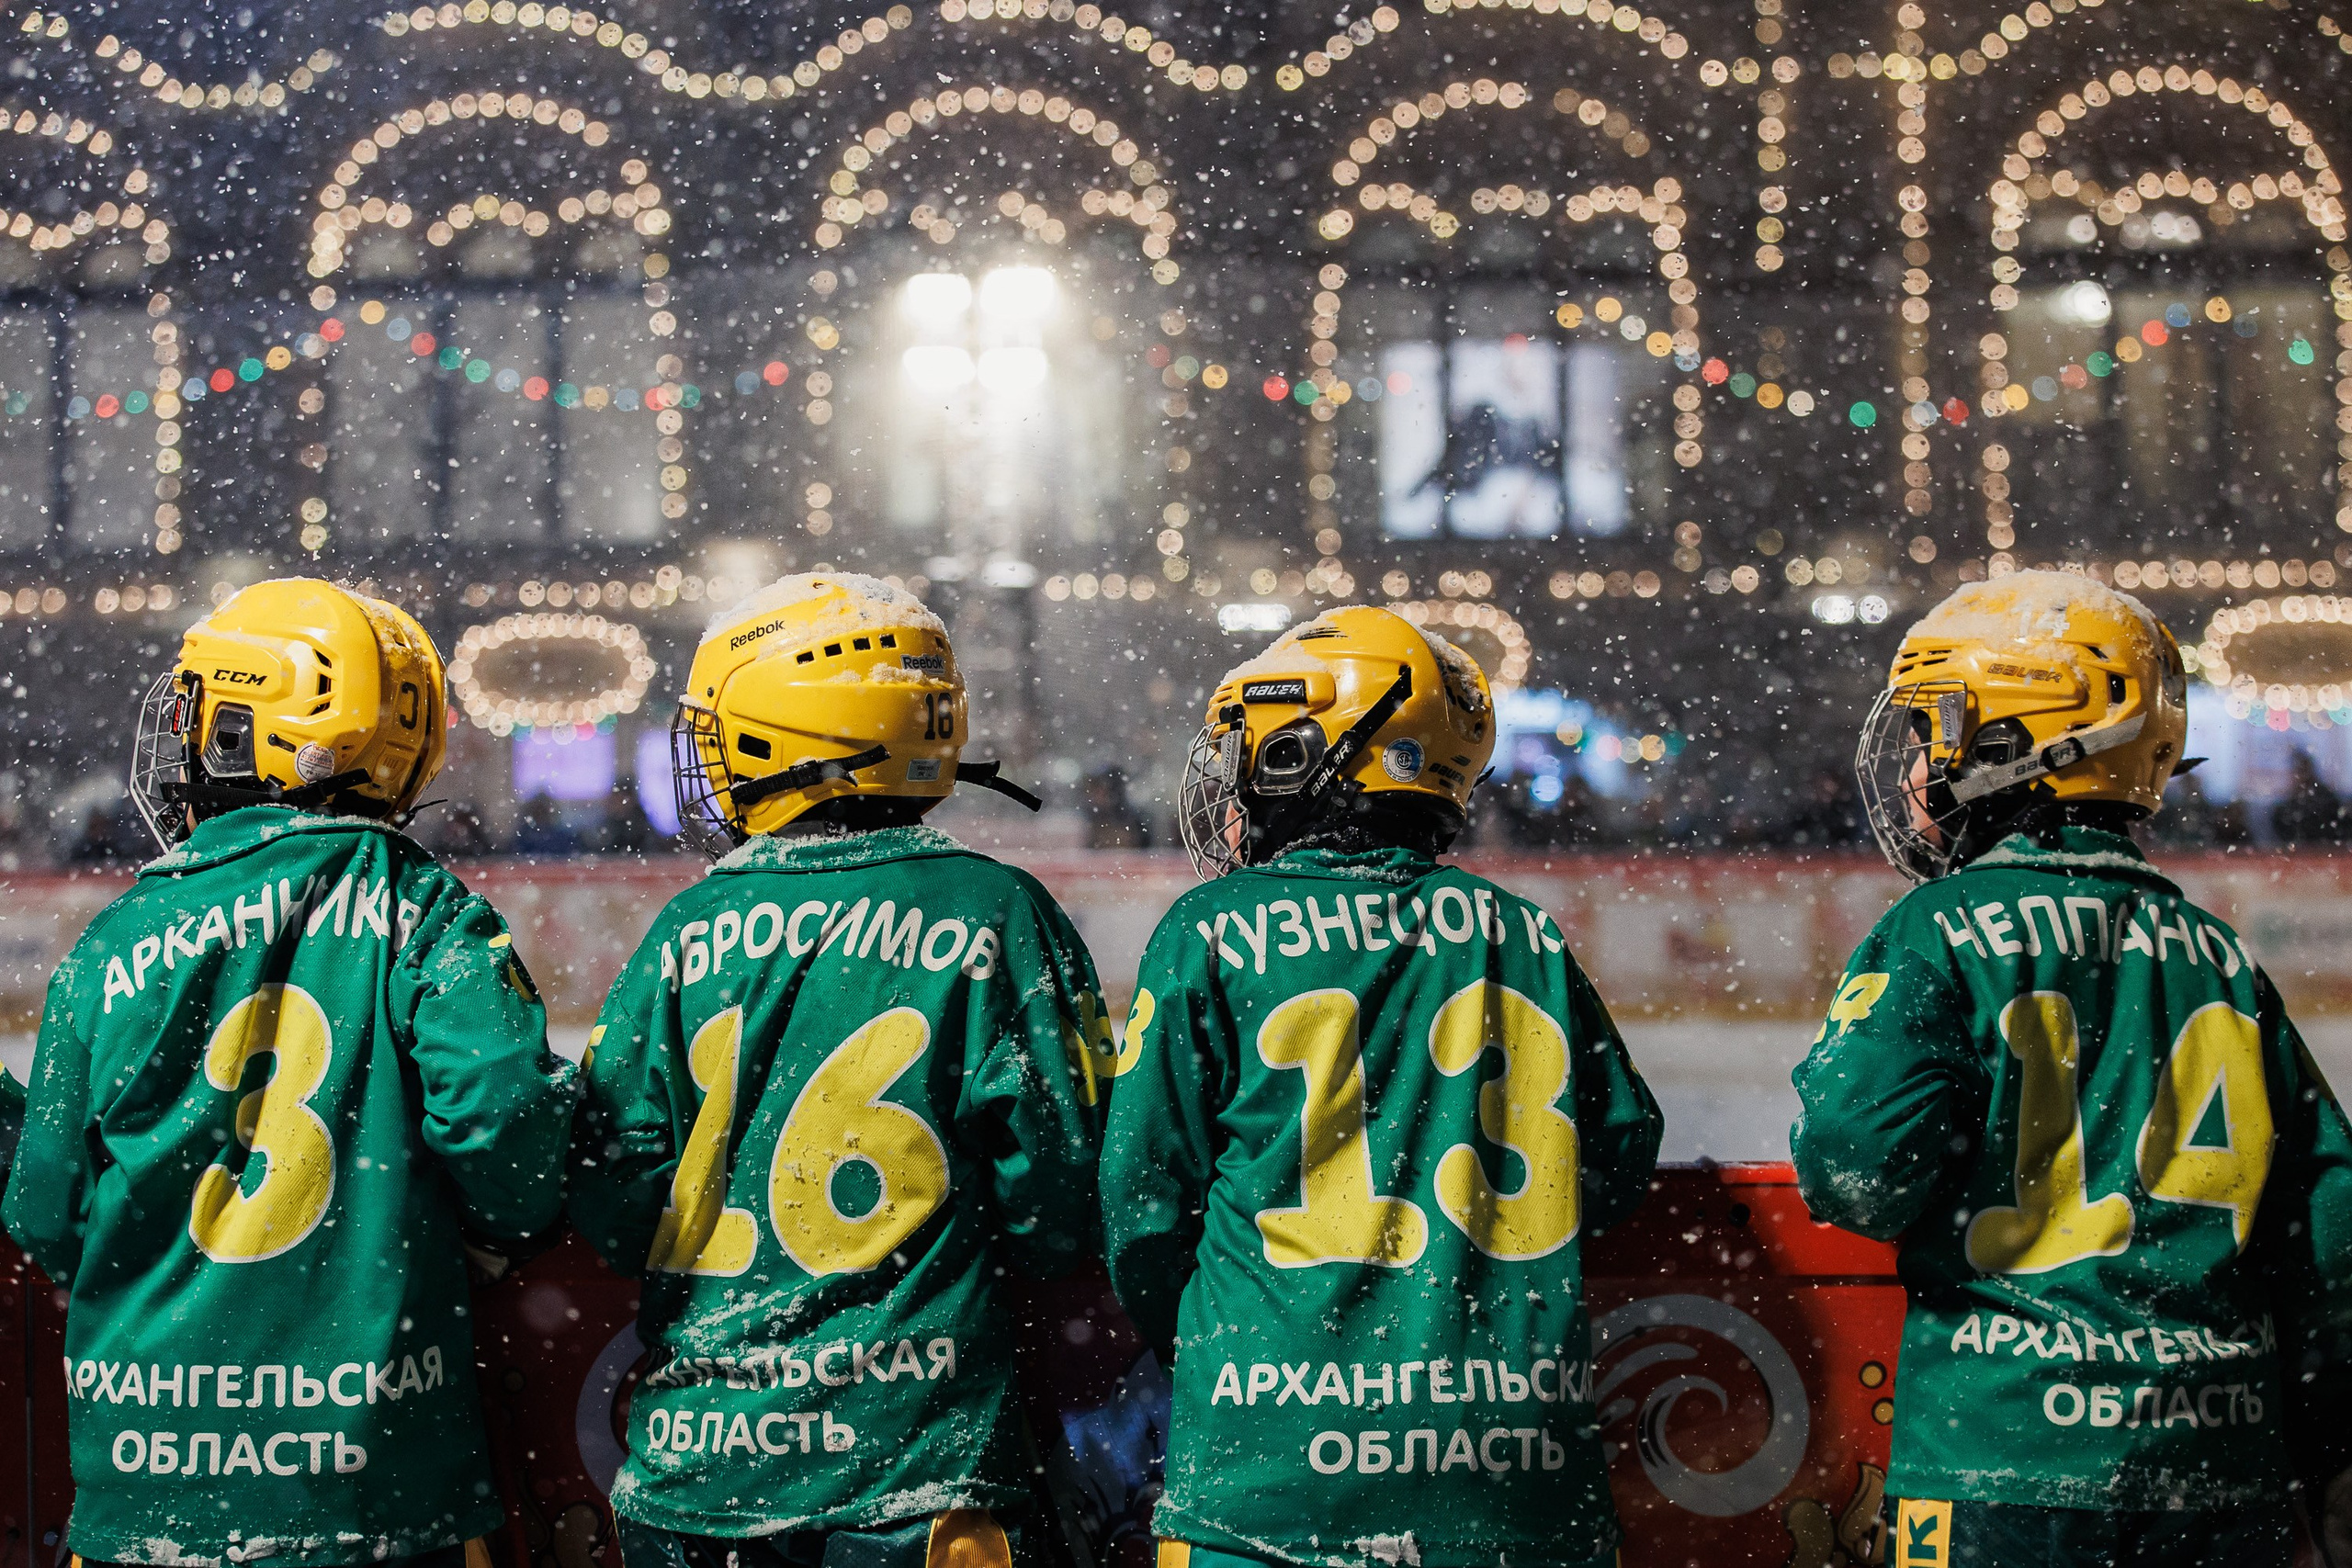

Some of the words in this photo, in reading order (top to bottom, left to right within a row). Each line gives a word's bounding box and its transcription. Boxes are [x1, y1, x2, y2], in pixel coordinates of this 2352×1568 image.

[730, 620, 786, 651] Reebok
[213, 669, 267, 686] CCM
[903, 656, 944, 671] Reebok
[1987, 662, 2063, 683] BAUER
[400, 682, 419, 730] 3
[1244, 683, 1303, 697] BAUER
[924, 692, 954, 740] 16
[656, 897, 1001, 1000] АБРОСИМОВ
[1196, 886, 1506, 976] КУЗНЕЦОВ
[188, 983, 336, 1264] 3
[646, 1006, 950, 1278] 16
[1255, 977, 1582, 1269] 13
[1965, 990, 2276, 1274] 14
[63, 1345, 445, 1408] АРХАНГЕЛЬСКАЯ
[2042, 1382, 2265, 1427] ОБЛАСТЬ
[112, 1429, 368, 1476] ОБЛАСТЬ
[649, 1408, 856, 1456] ОБЛАСТЬ
[1308, 1427, 1566, 1474] ОБЛАСТЬ
